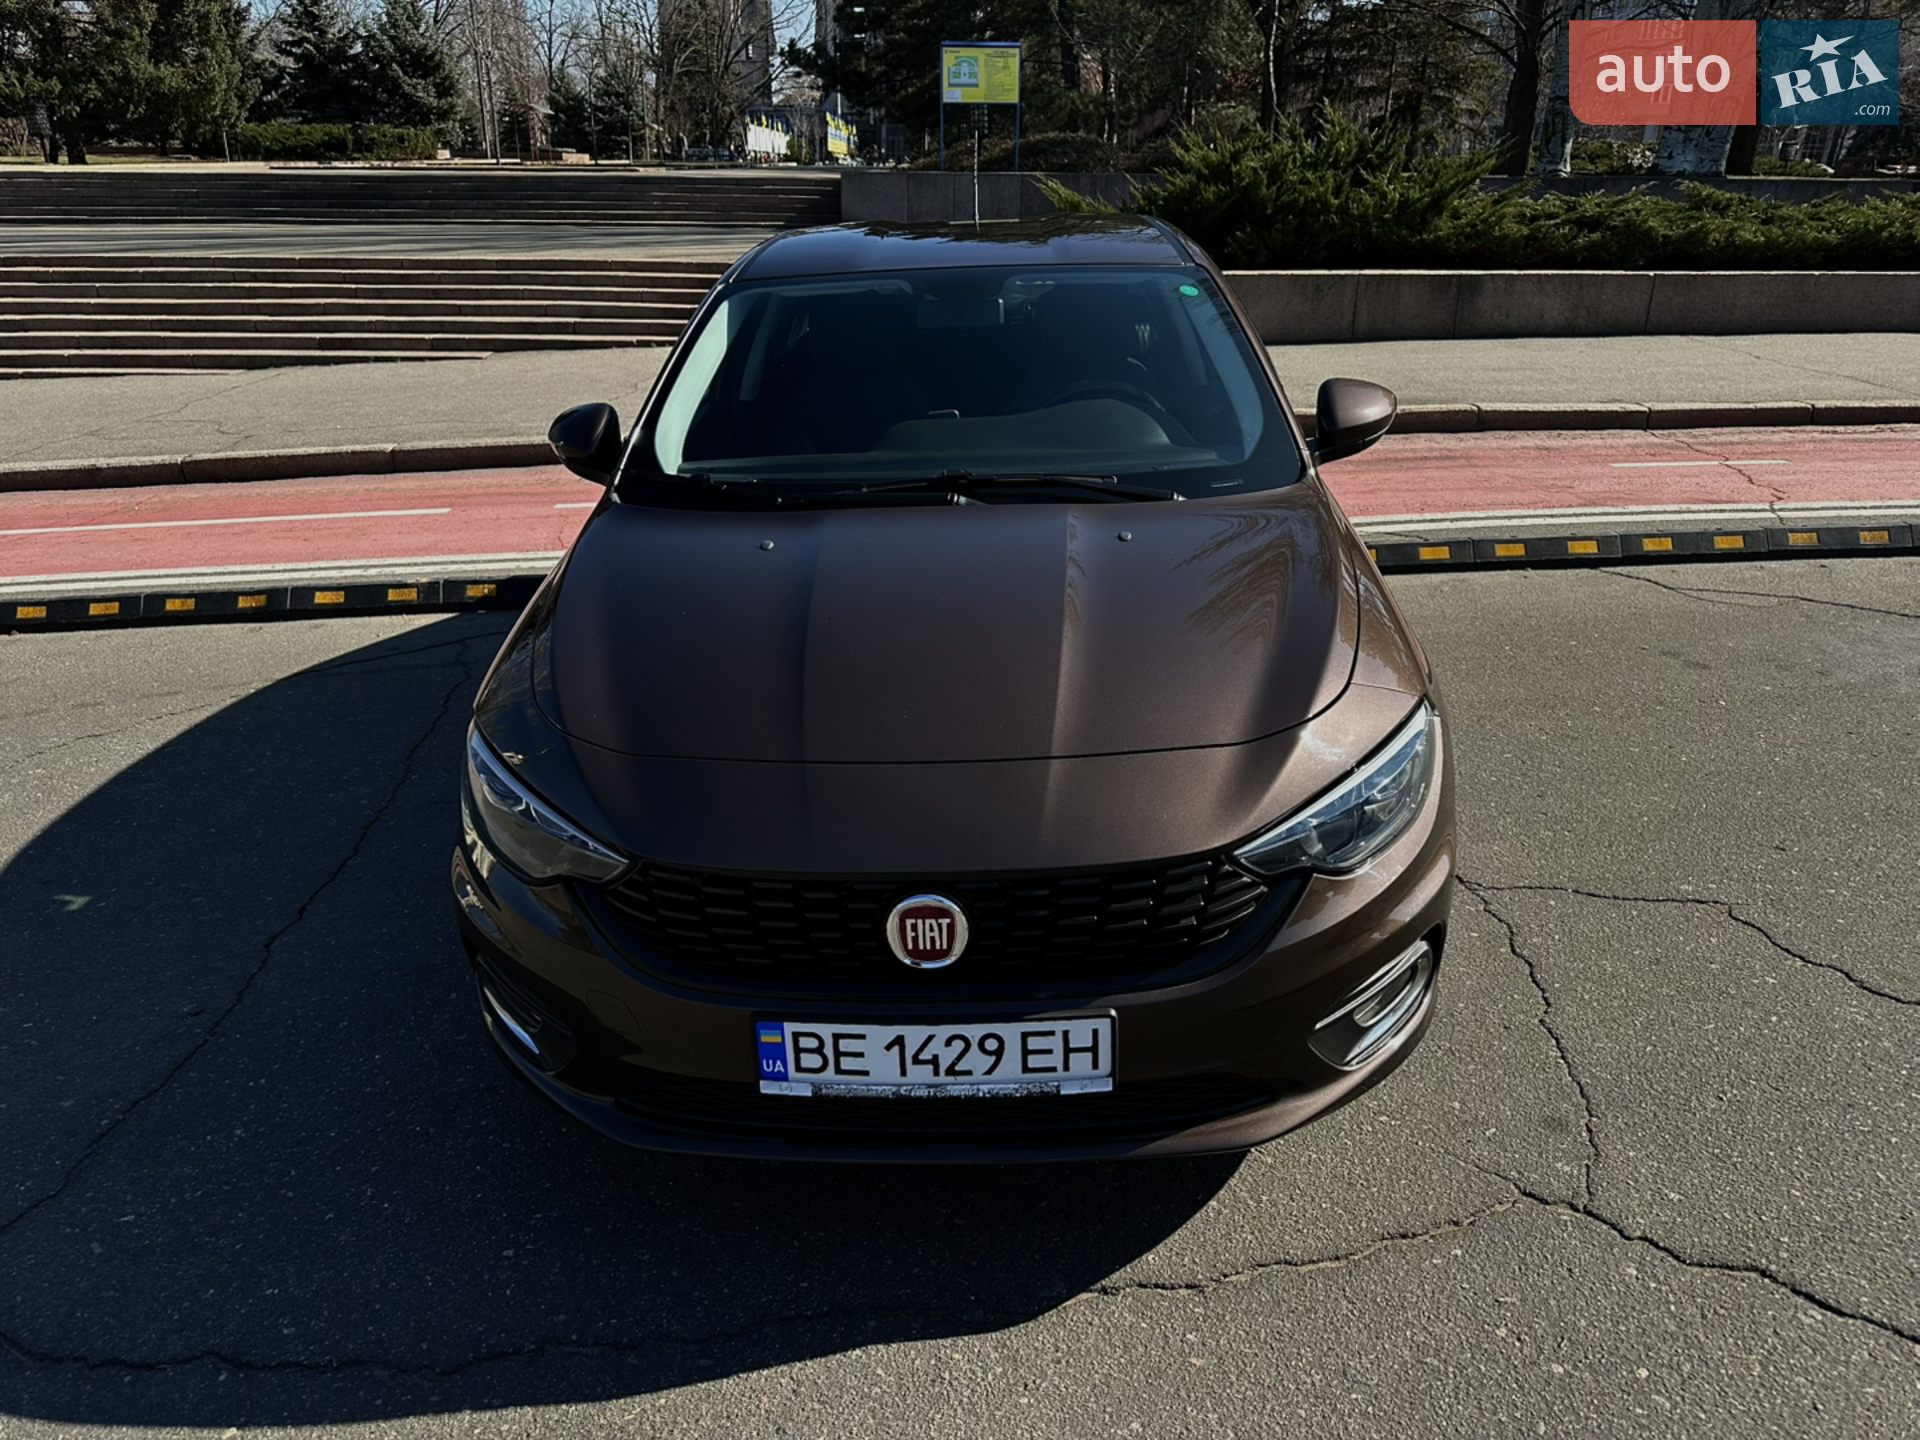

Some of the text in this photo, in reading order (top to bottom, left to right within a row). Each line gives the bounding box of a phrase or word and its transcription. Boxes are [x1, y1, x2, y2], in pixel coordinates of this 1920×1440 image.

[905, 918, 951, 950] FIAT
[763, 1058, 785, 1073] UA
[791, 1028, 1100, 1078] BE 1429 EH
